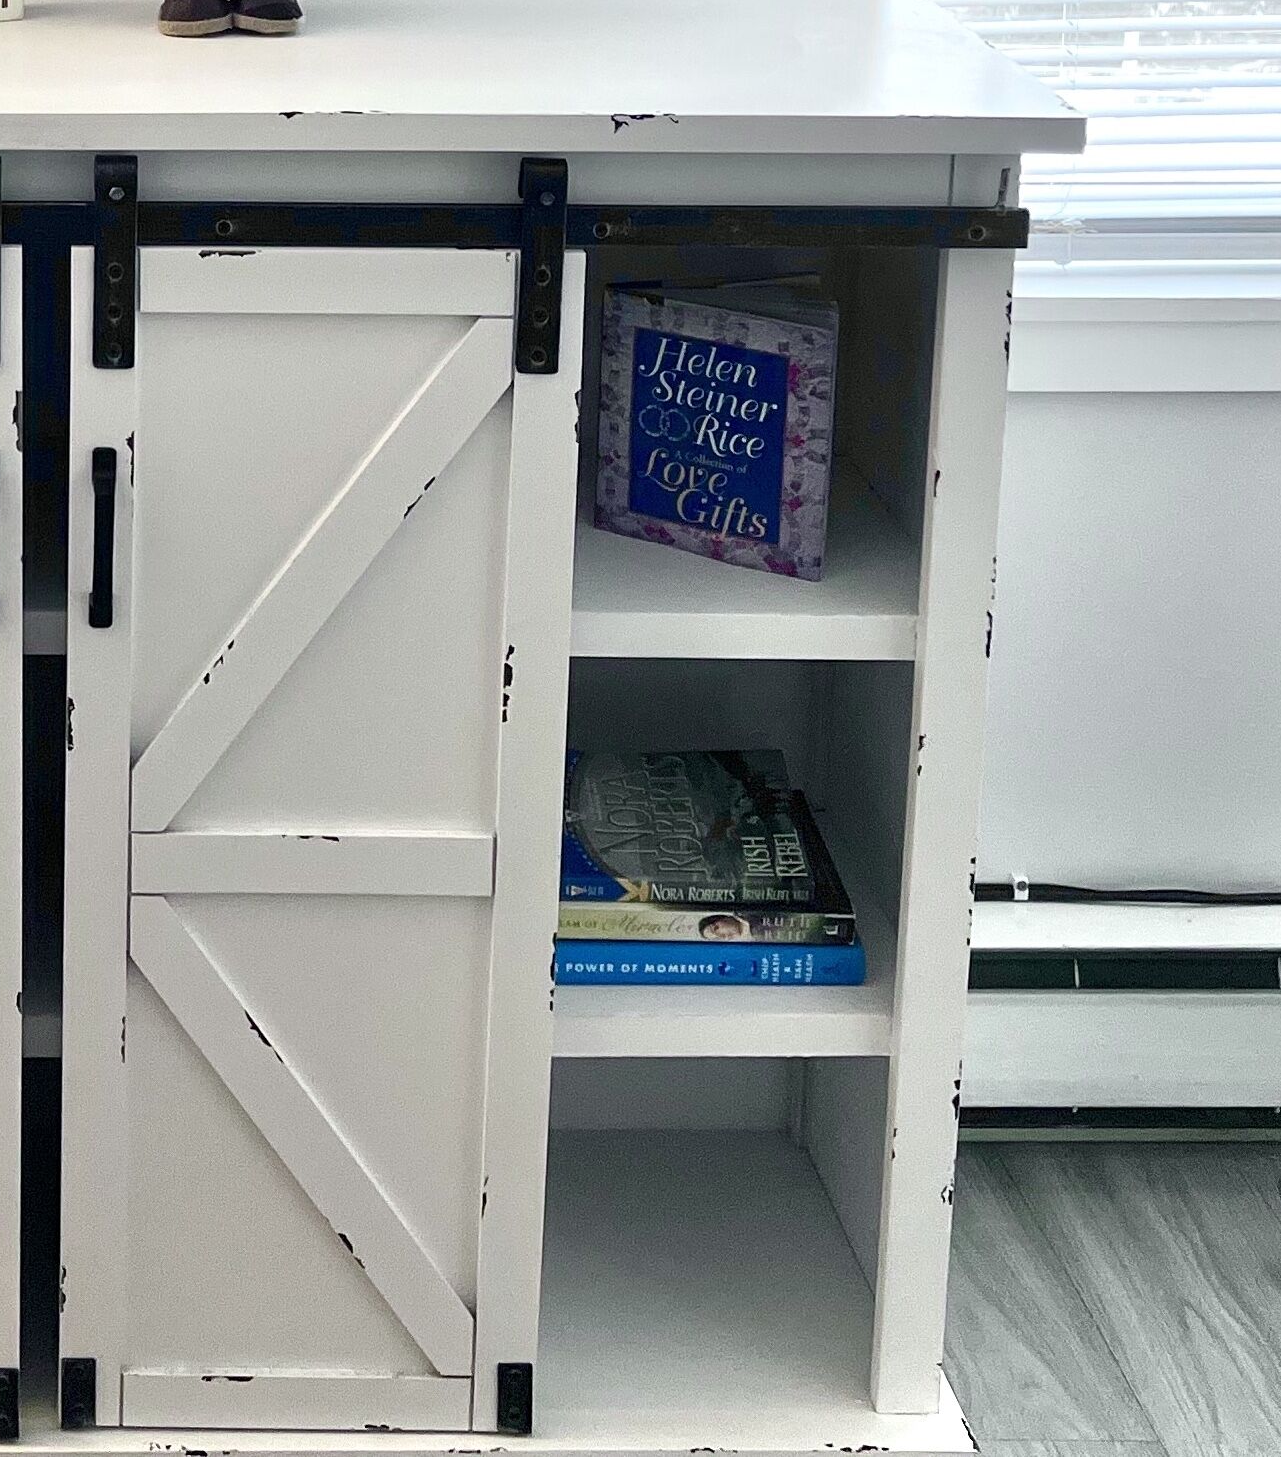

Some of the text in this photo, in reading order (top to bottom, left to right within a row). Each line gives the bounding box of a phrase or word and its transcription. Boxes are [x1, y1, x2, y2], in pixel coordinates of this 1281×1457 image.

[638, 336, 758, 389] Helen
[651, 370, 779, 423] Steiner
[693, 413, 765, 459] Rice
[637, 447, 728, 496] Love
[676, 488, 768, 538] Gifts
[594, 771, 658, 857] NORA
[740, 836, 775, 877] IRISH
[773, 827, 808, 877] REBEL
[651, 883, 685, 901] NORA
[688, 886, 736, 902] ROBERTS
[565, 962, 614, 973] POWER
[620, 963, 638, 974] OF
[644, 963, 714, 974] MOMENTS
